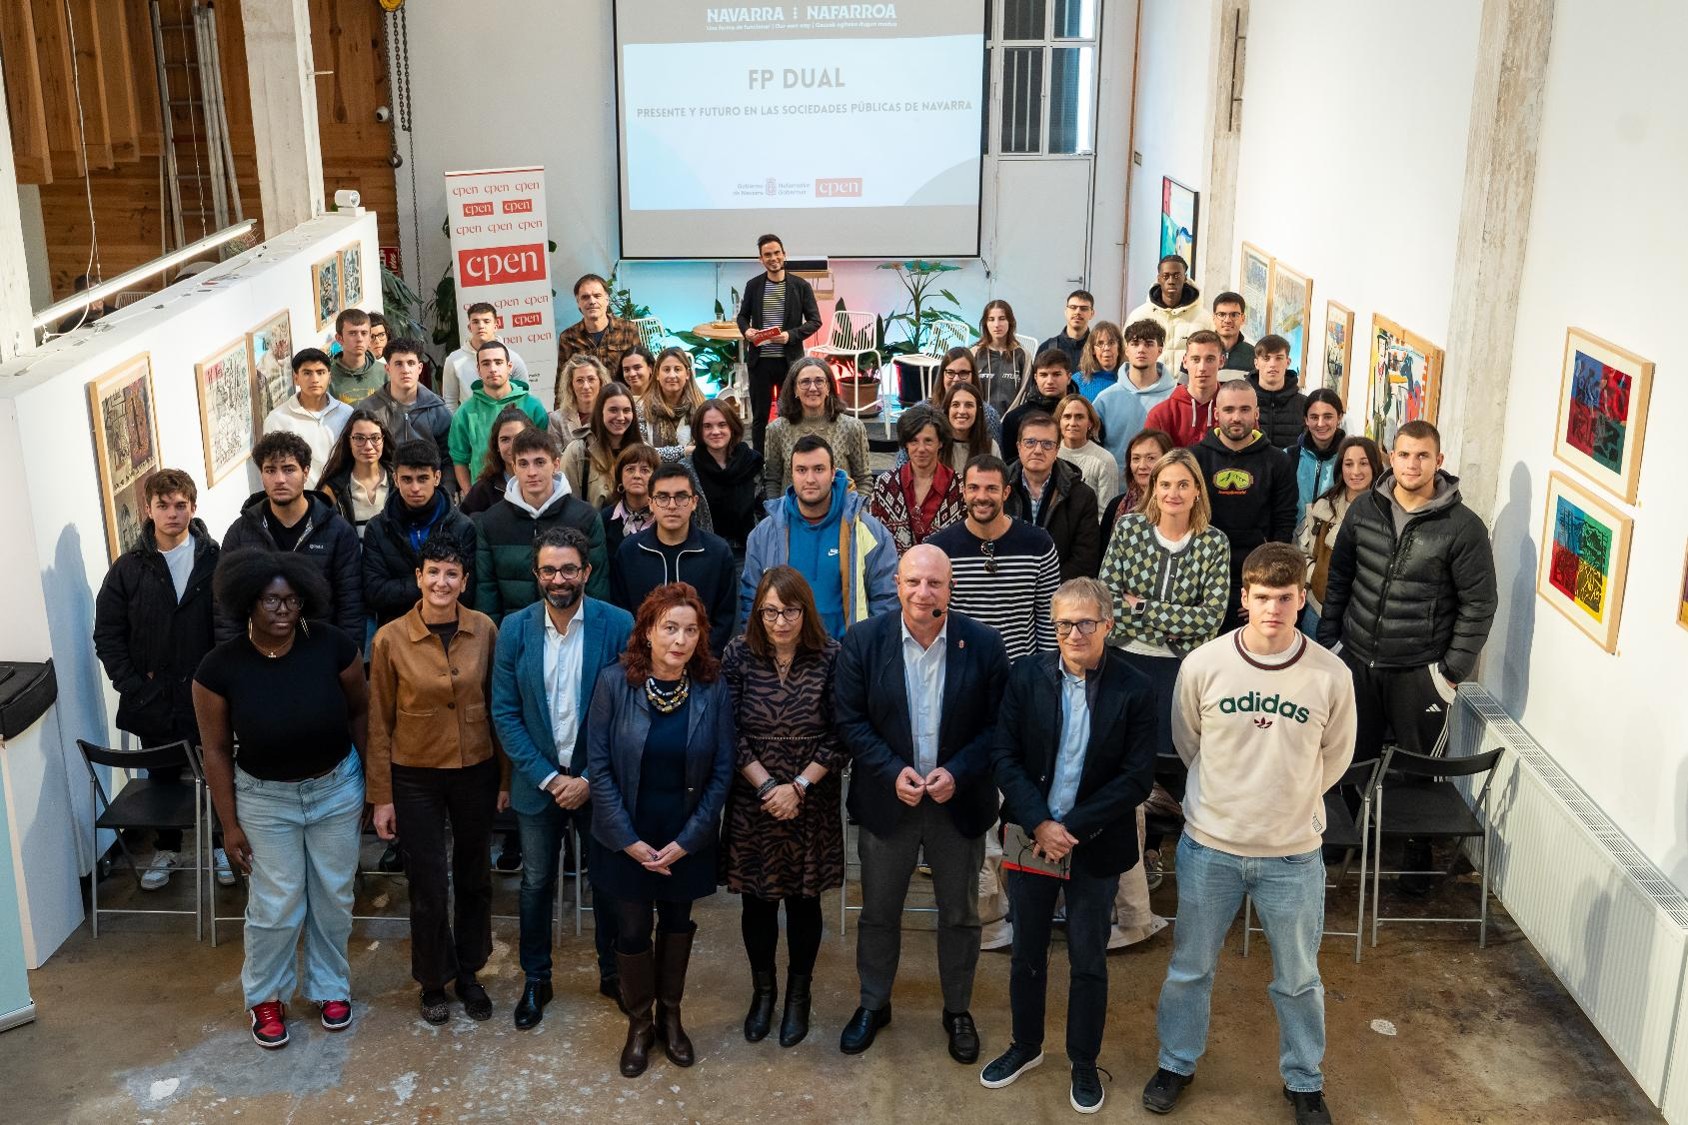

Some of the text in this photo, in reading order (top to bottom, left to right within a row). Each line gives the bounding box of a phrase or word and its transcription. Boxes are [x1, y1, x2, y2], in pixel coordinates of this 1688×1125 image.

[706, 4, 897, 22] NAVARRA NAFARROA
[748, 68, 845, 90] FP DUAL
[637, 100, 972, 118] PRESENTE Y FUTURO EN LAS SOCIEDADES PÚBLICAS DE NAVARRA
[452, 182, 540, 197] cpen cpen cpen
[819, 182, 859, 196] cpen
[465, 204, 492, 215] cpen
[504, 201, 530, 212] cpen
[456, 220, 543, 235] cpen cpen cpen
[466, 251, 538, 281] cpen
[494, 298, 519, 309] cpen
[524, 295, 549, 305] cpen
[514, 314, 540, 325] cpen
[528, 332, 552, 343] cpen
[1219, 691, 1309, 724] adidas
